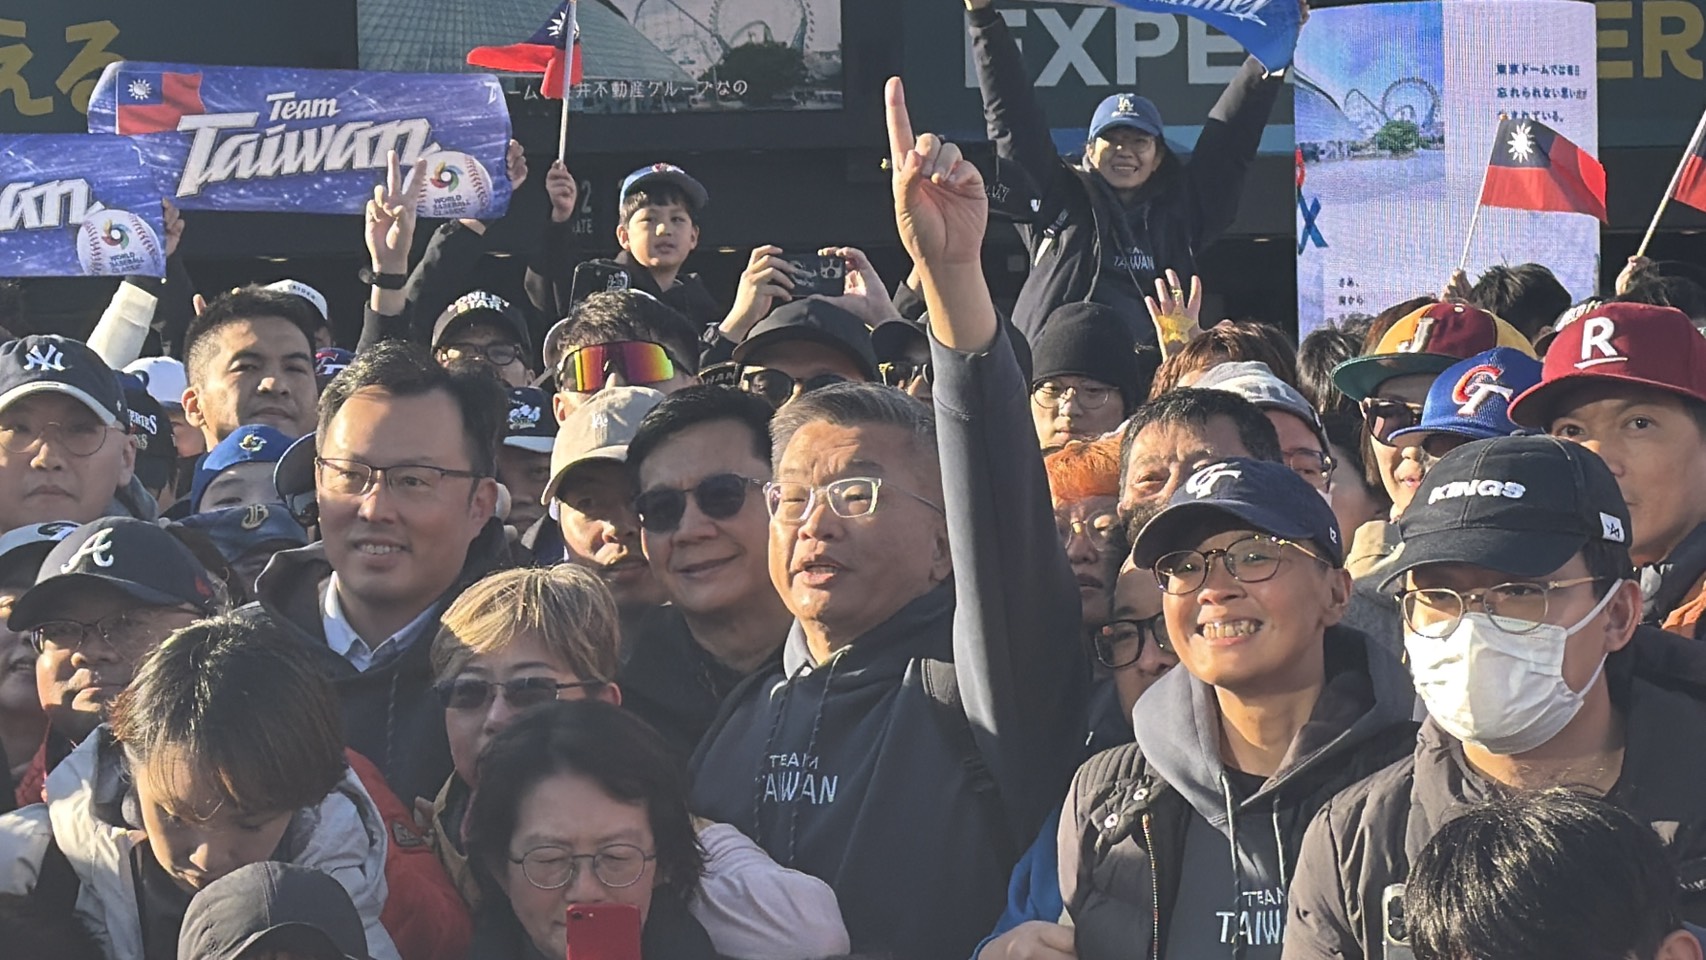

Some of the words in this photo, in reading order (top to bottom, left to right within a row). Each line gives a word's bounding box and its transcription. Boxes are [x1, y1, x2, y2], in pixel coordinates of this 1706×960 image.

[266, 91, 341, 121] Team
[508, 80, 748, 99] ーム井不動産グループなの
[176, 112, 441, 197] Taiwan
[1396, 317, 1435, 353] J
[1581, 316, 1619, 361] R
[23, 343, 66, 371] NY
[1428, 479, 1526, 505] KINGS
[61, 527, 114, 574] A
[1216, 909, 1281, 945] TAIW
